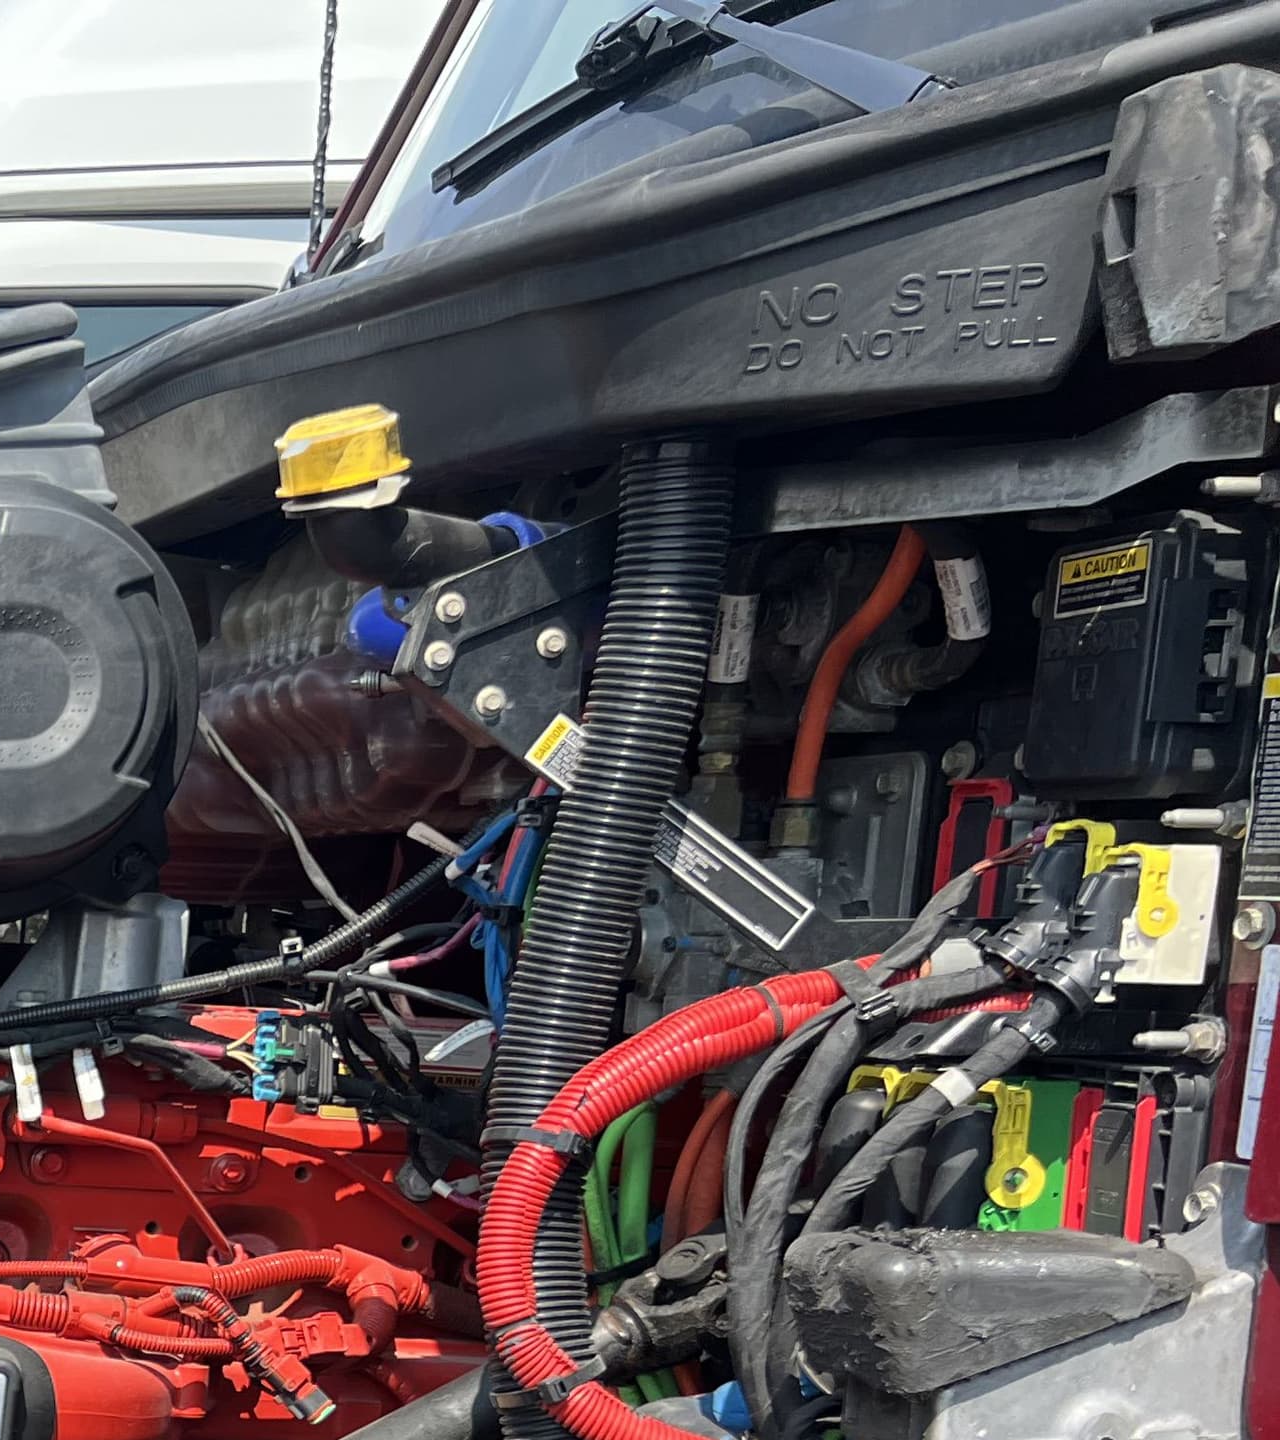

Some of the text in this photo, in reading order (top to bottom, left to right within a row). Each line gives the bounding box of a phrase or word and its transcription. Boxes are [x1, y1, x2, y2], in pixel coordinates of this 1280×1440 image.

[751, 262, 1050, 333] NO STEP
[743, 317, 1057, 374] DO NOT PULL
[1084, 553, 1137, 576] CAUTION
[534, 723, 566, 760] CAUTION
